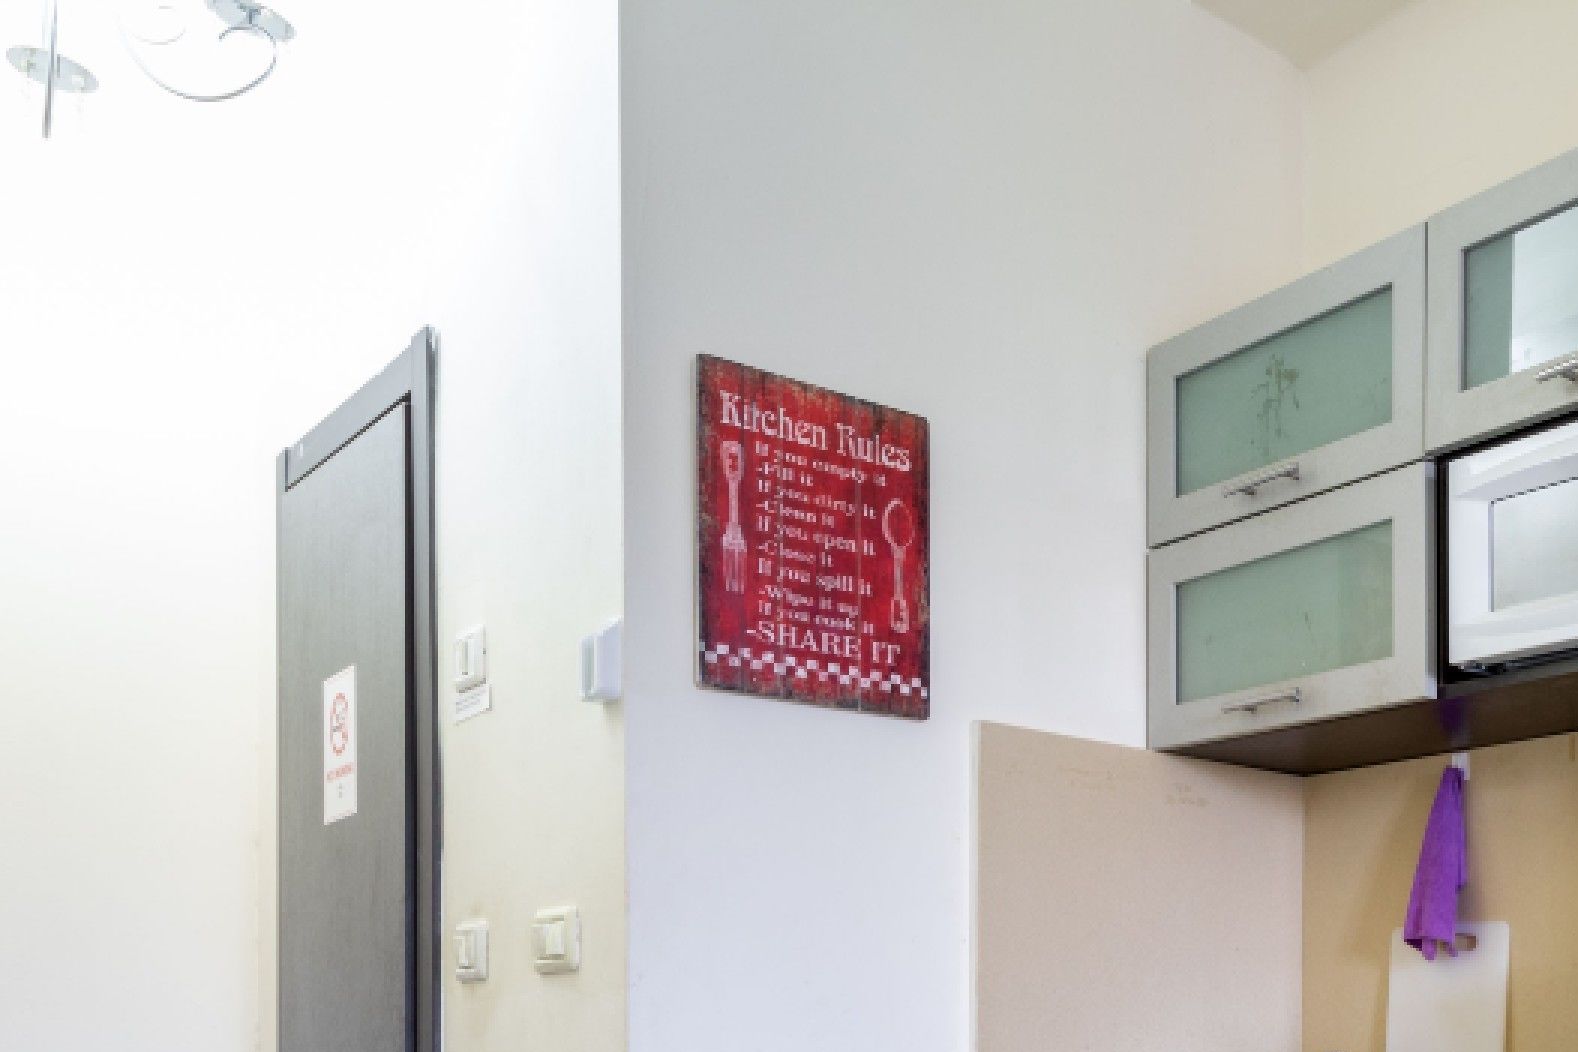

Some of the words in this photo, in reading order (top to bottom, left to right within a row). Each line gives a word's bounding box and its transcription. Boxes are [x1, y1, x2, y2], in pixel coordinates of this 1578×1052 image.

[720, 389, 828, 450] Kitchen
[836, 422, 912, 472] Rules
[774, 449, 808, 466] you
[773, 485, 809, 502] you
[773, 523, 808, 542] you
[812, 533, 856, 553] open
[776, 566, 811, 583] you
[815, 573, 853, 592] spill
[746, 620, 862, 658] -SHARE
[871, 640, 901, 666] IT
